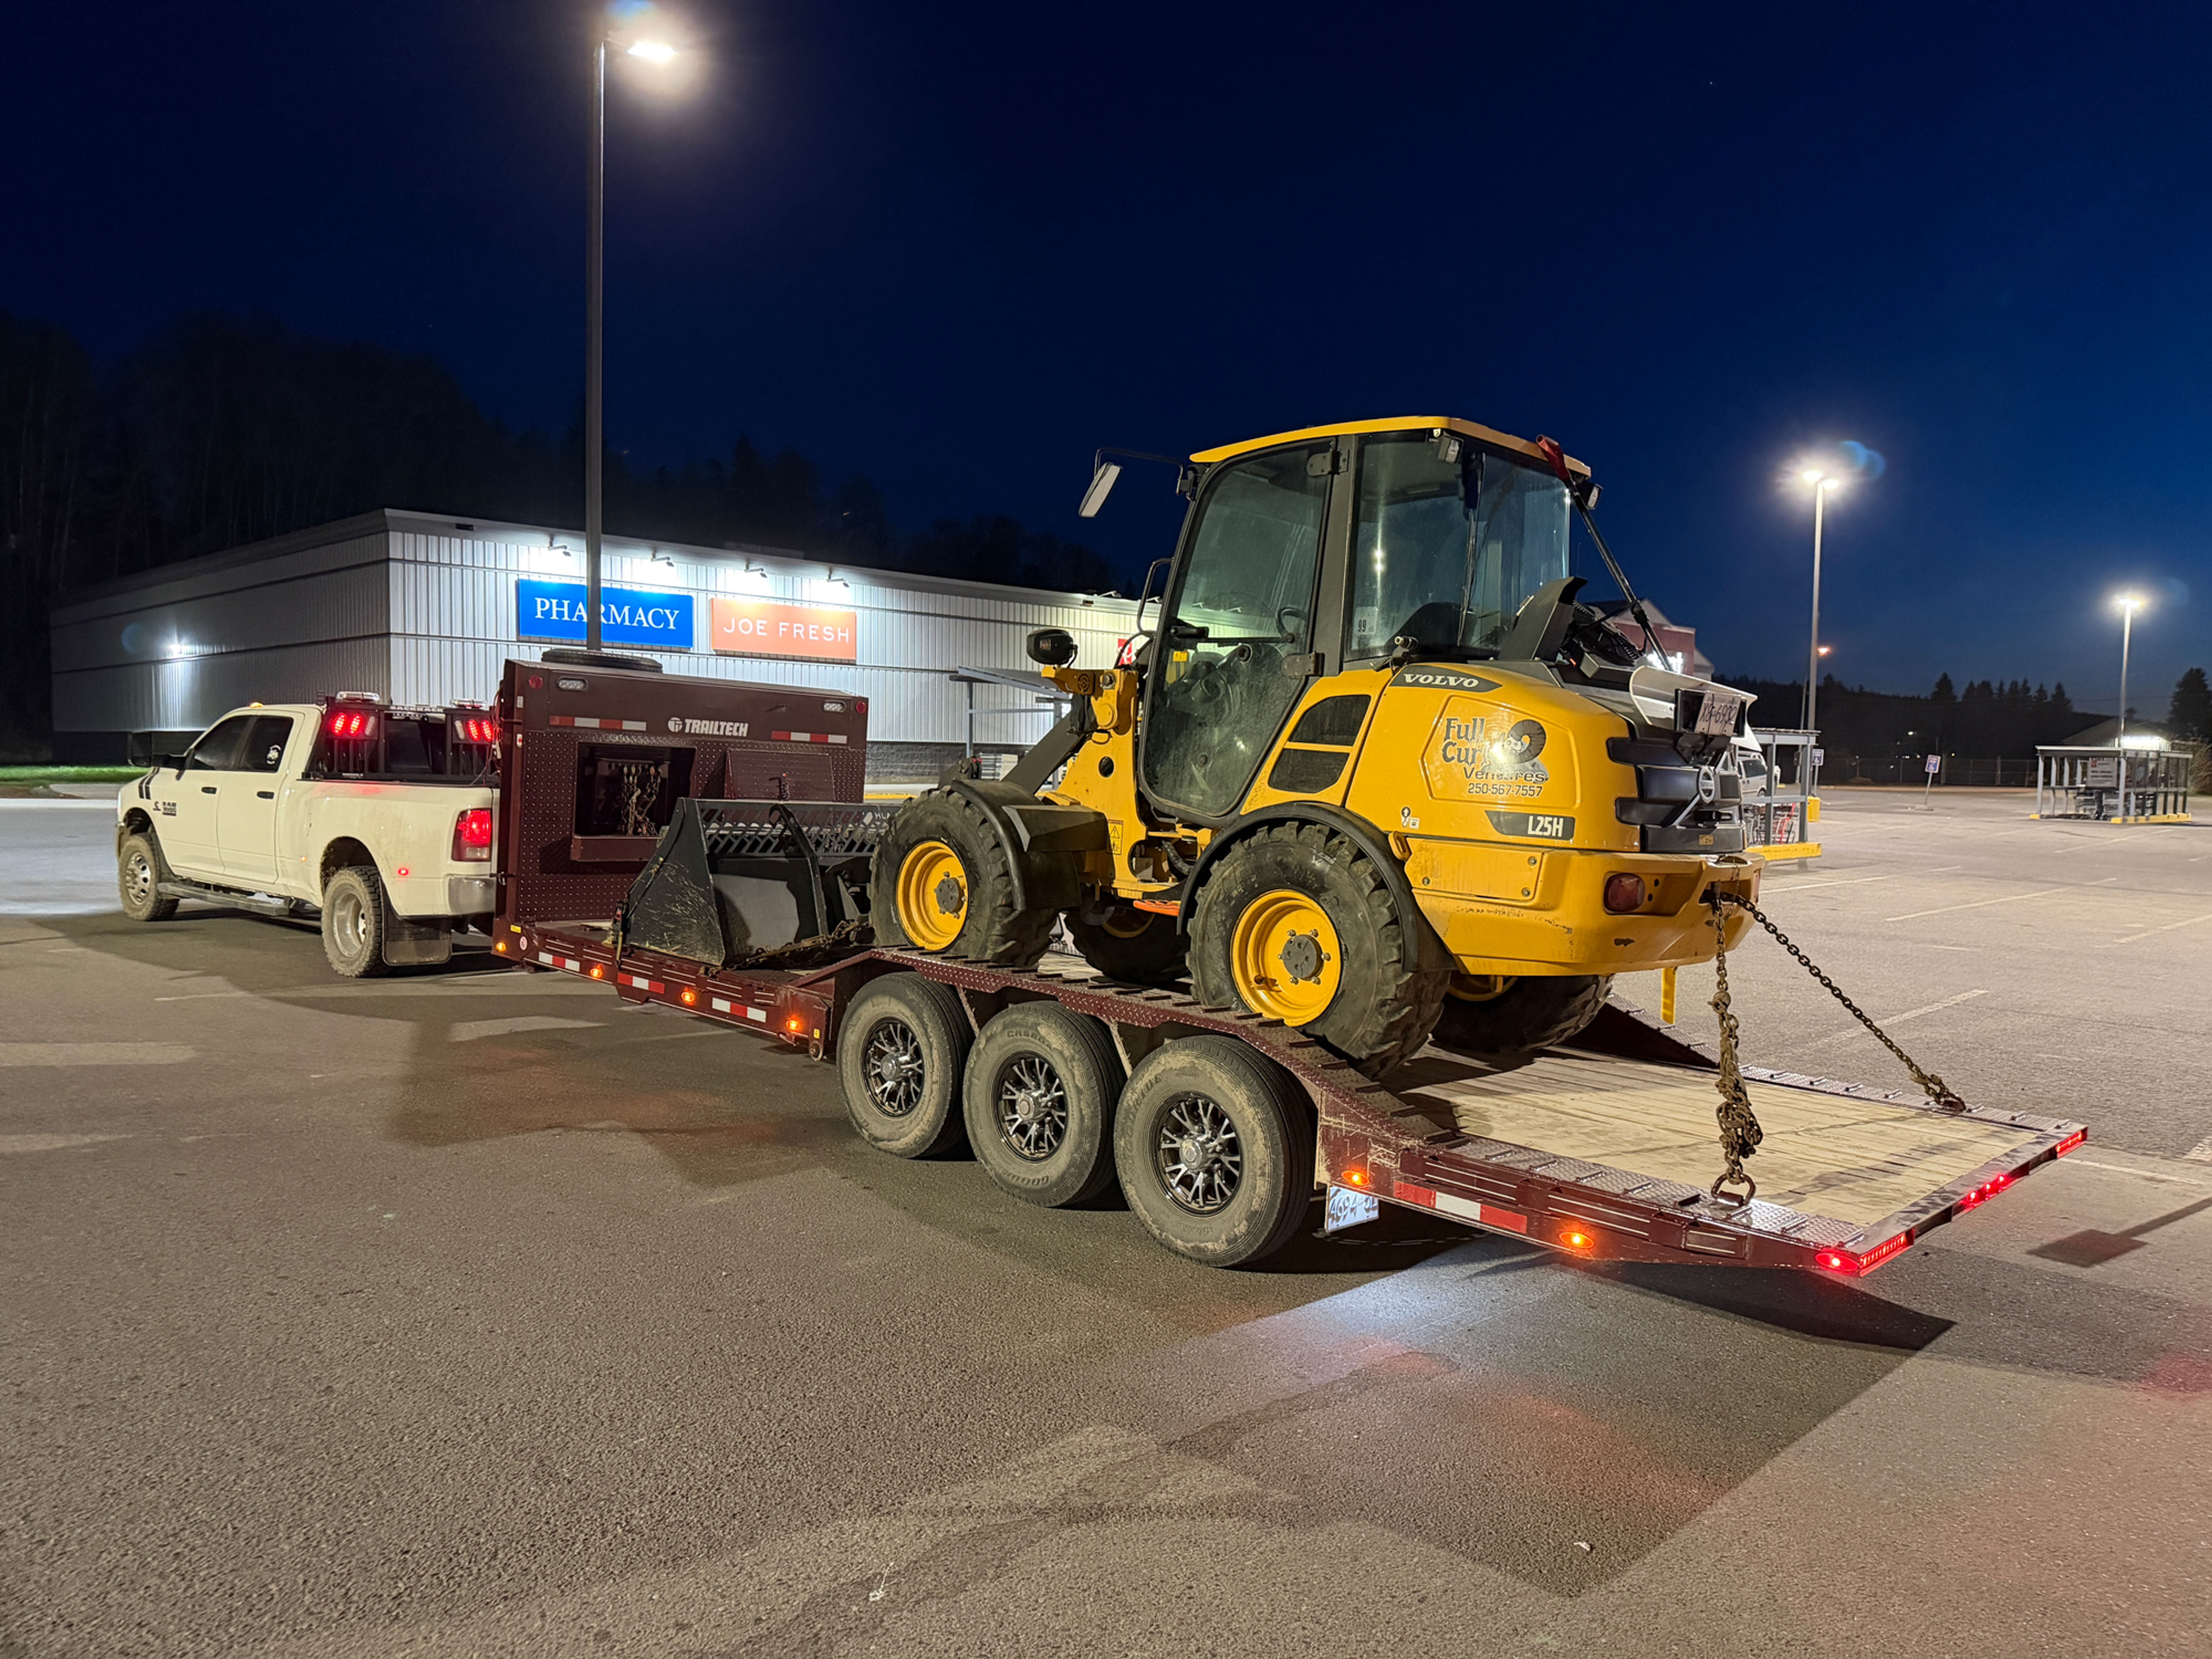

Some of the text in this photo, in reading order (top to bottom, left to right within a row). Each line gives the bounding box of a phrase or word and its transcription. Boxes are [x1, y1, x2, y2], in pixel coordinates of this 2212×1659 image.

[723, 618, 849, 642] JOE FRESH
[1403, 673, 1479, 688] VOLVO
[684, 718, 749, 737] TRAILTECH
[1444, 718, 1486, 741] Full
[1442, 741, 1489, 766] Cur
[1468, 782, 1543, 797] 250-567-7557
[1528, 816, 1563, 837] L25H
